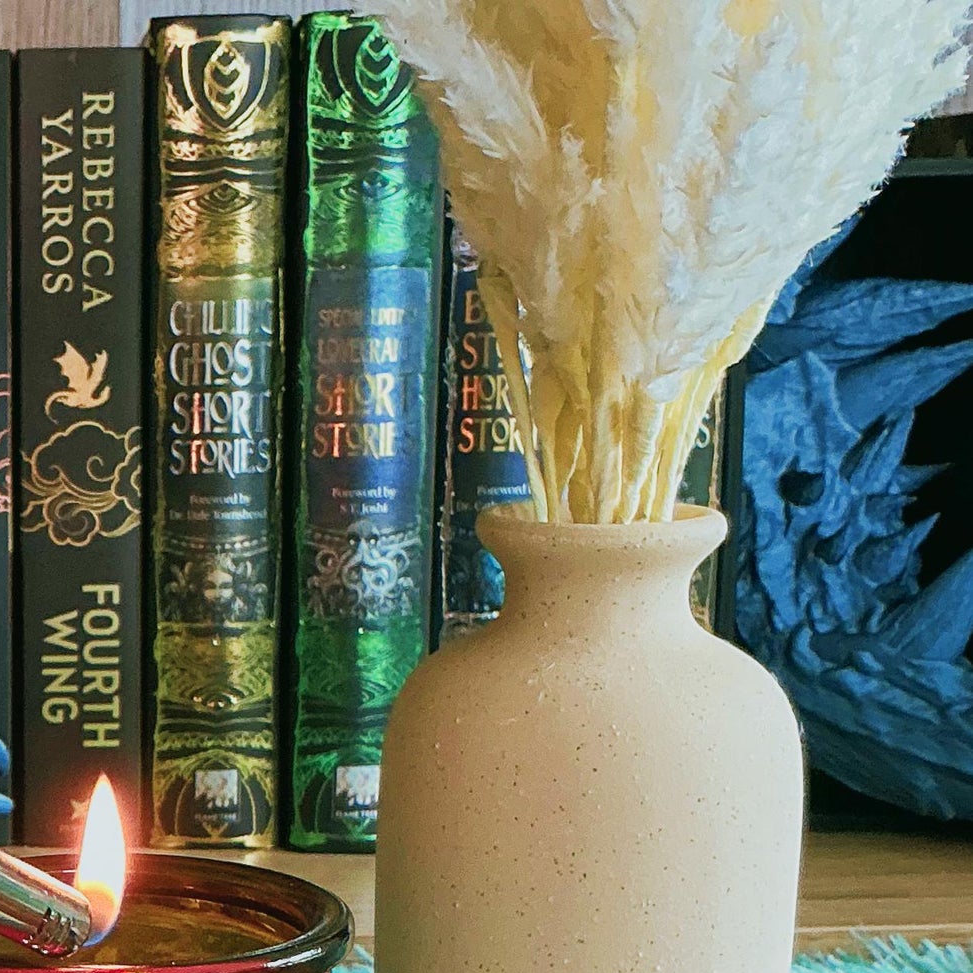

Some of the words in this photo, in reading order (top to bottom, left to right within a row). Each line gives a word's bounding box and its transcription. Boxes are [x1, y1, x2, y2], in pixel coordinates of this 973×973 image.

[42, 109, 74, 295] YARROS
[82, 91, 115, 312] REBECCA
[169, 339, 272, 387] GHOST
[170, 390, 271, 440] SHORT
[312, 422, 414, 460] STORIE
[169, 439, 272, 479] STORIES
[41, 609, 77, 724] WING
[81, 583, 120, 749] FOURTH
